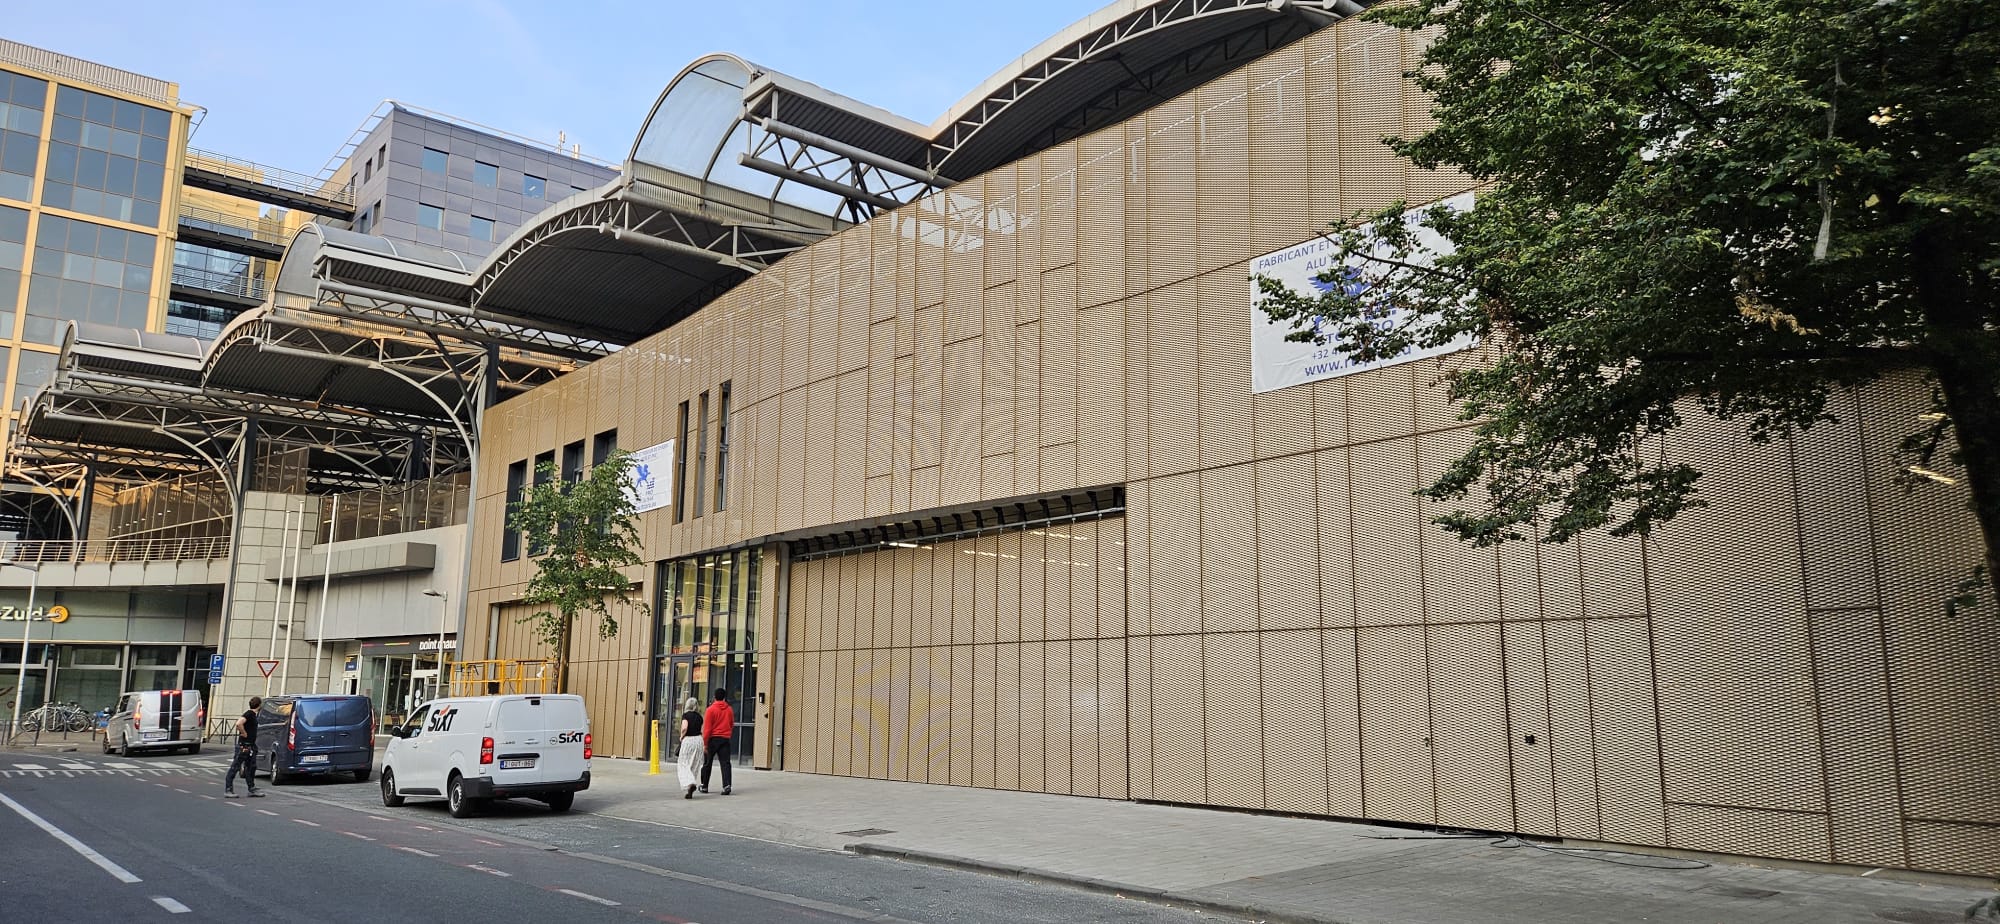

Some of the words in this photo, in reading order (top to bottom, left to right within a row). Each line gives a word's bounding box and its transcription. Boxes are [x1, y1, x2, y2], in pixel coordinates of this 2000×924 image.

[1259, 243, 1316, 270] FABRICANT
[1318, 239, 1331, 252] ET
[1305, 256, 1327, 271] ALU
[1312, 349, 1329, 360] +32
[419, 638, 438, 650] point
[213, 655, 222, 665] P
